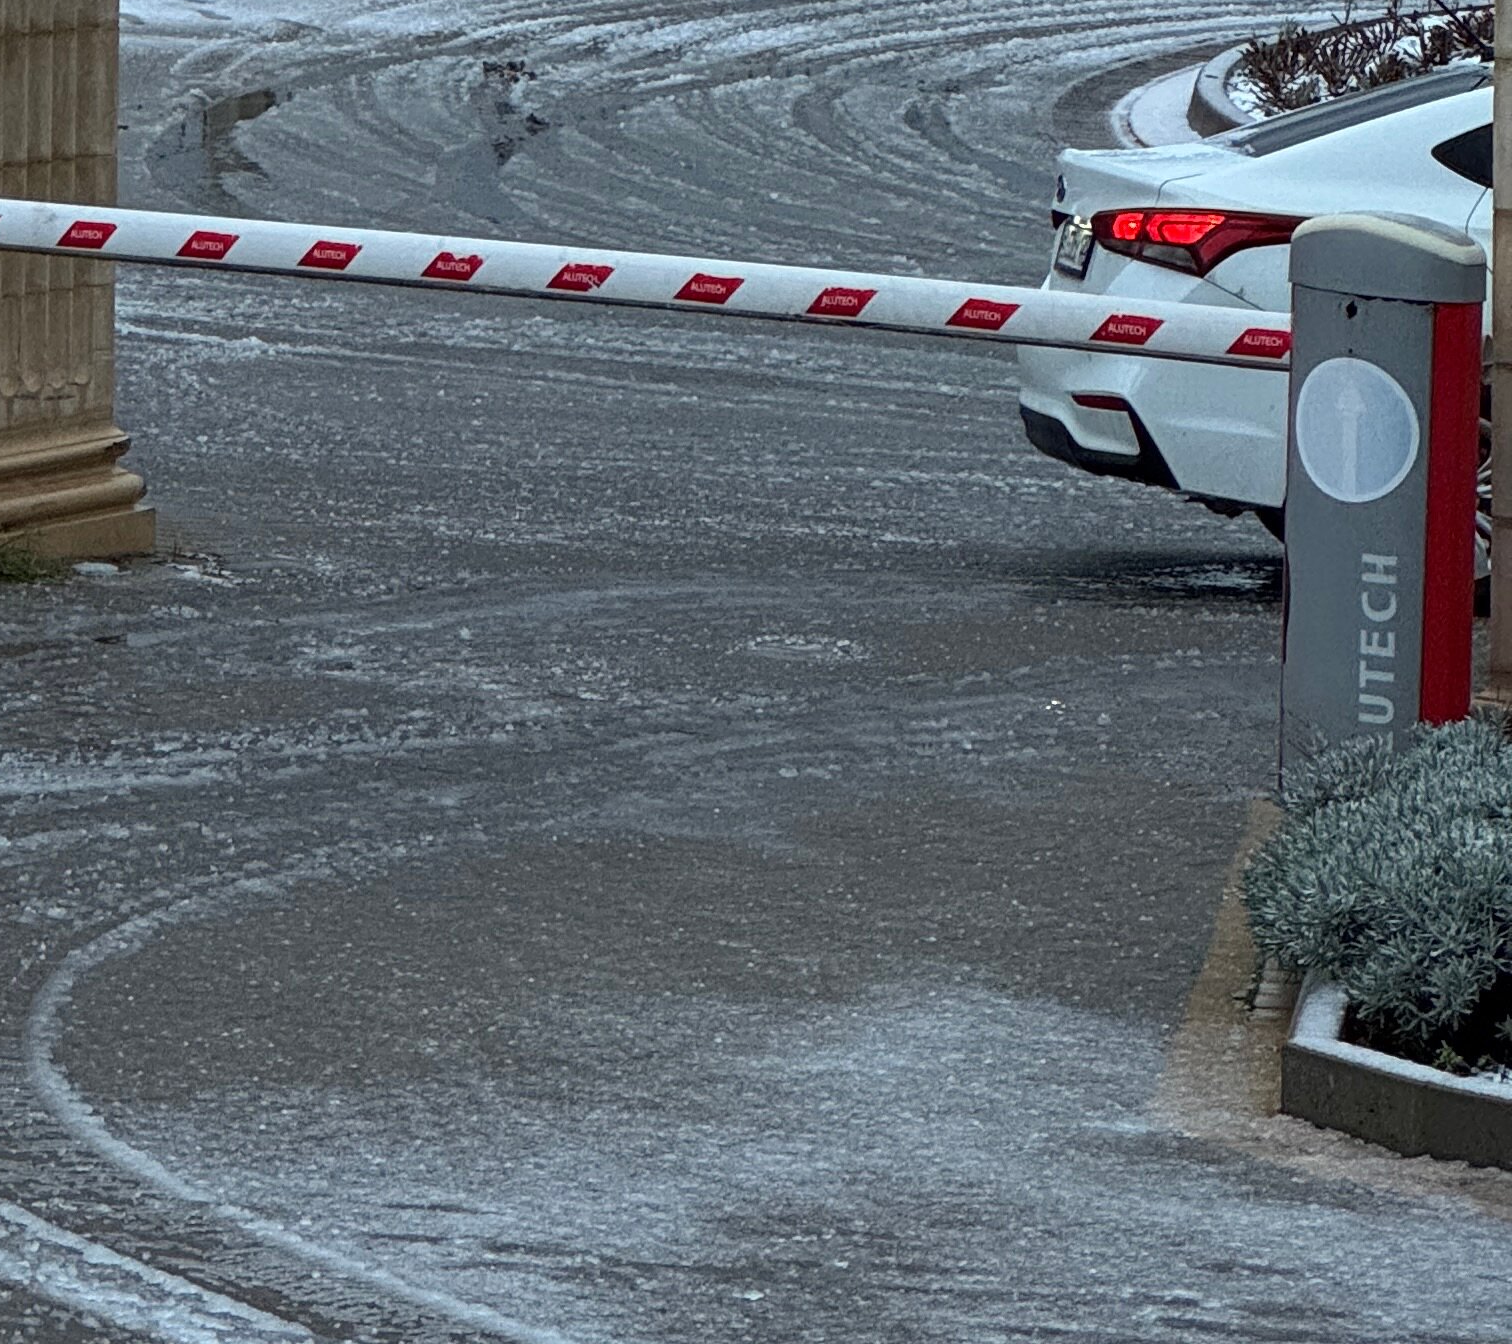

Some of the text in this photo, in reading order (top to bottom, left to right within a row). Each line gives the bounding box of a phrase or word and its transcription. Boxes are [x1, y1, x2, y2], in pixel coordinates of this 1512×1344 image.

[70, 229, 103, 240] ALUTECH
[191, 240, 224, 251] ALUTECH
[313, 249, 346, 261] ALUTECH
[436, 261, 471, 272] ALUTECH
[691, 281, 726, 294] ALUTECH
[822, 295, 858, 307] ALUTECH
[963, 309, 1001, 321] ALUTECH
[1108, 323, 1146, 336] ALUTECH
[1243, 334, 1283, 347] ALUTECH
